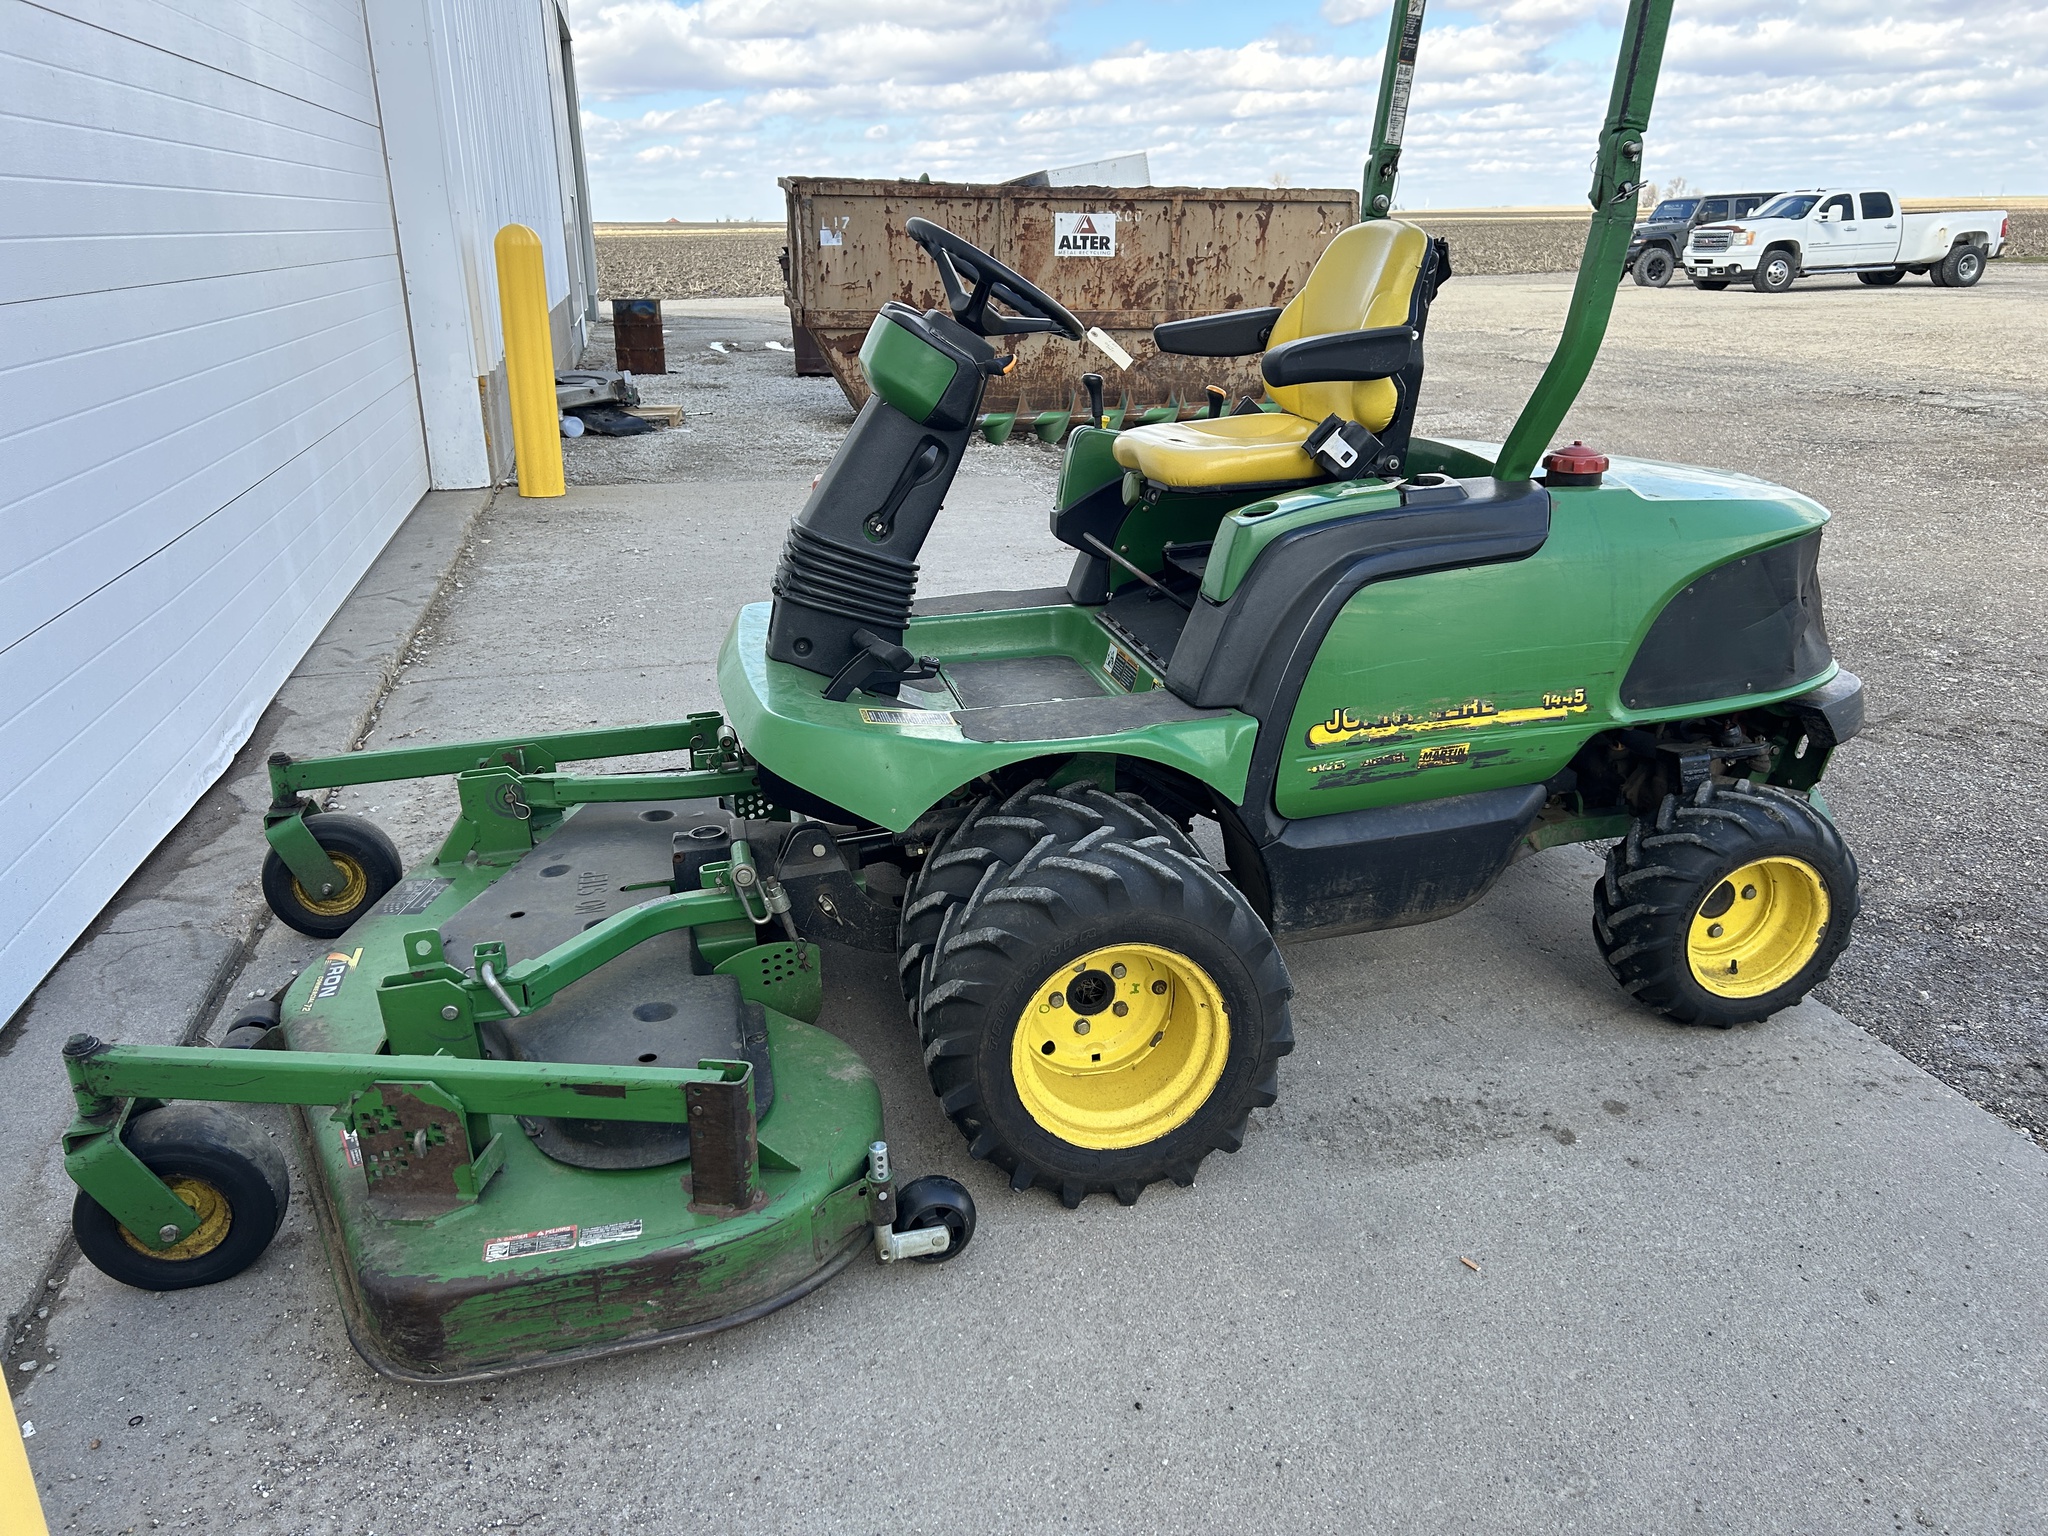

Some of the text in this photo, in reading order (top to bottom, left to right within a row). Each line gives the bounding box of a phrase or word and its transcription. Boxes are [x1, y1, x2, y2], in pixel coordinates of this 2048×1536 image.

[1058, 235, 1111, 250] ALTER
[1012, 926, 1097, 994] POWER
[318, 961, 347, 998] IRON
[301, 1003, 313, 1012] 72
[544, 1226, 571, 1236] PELIGRO
